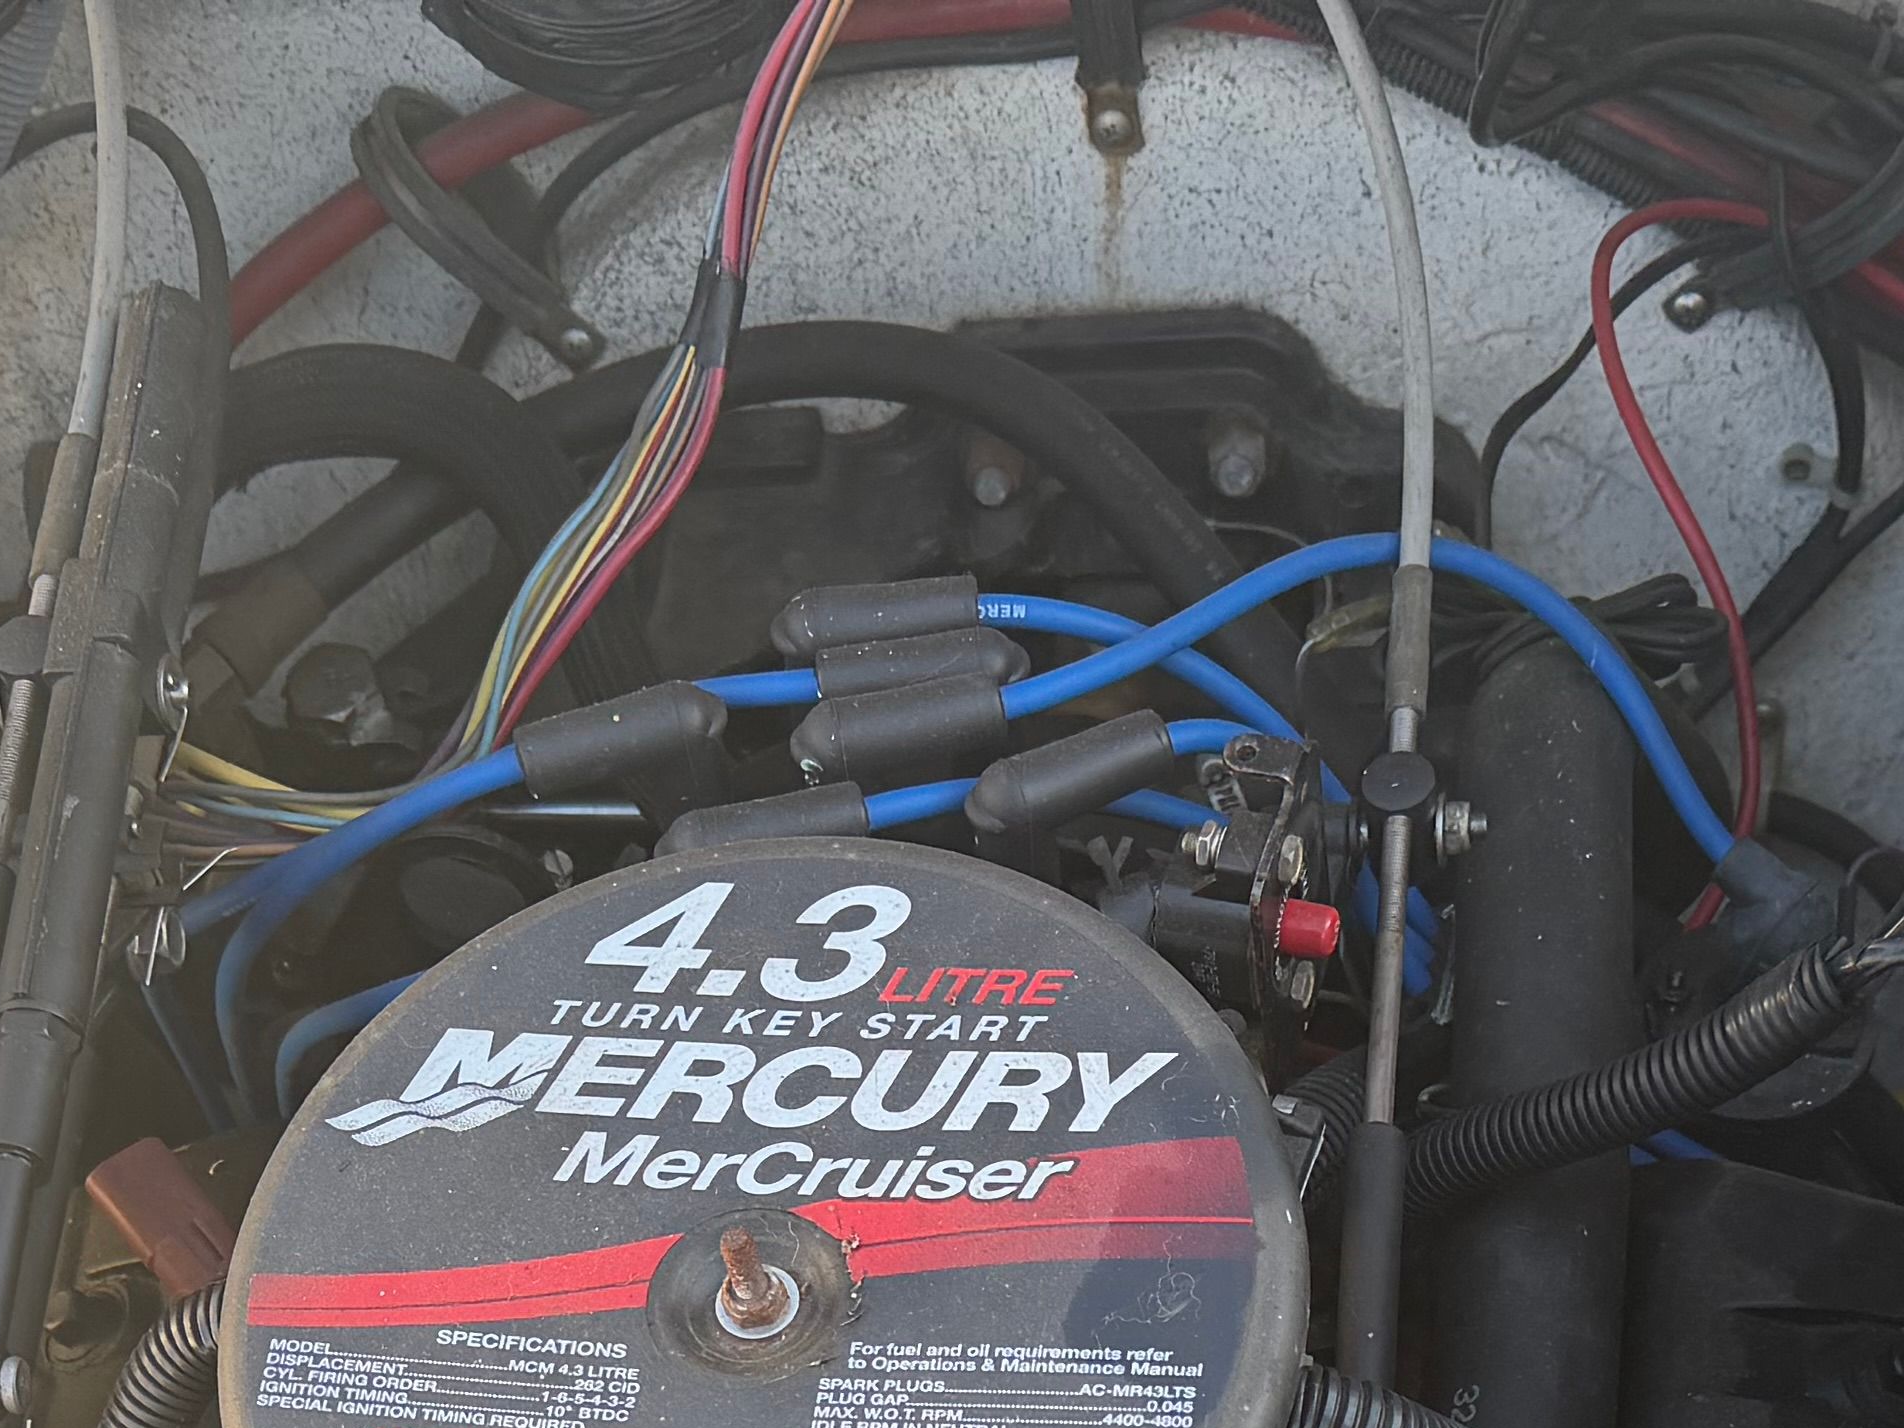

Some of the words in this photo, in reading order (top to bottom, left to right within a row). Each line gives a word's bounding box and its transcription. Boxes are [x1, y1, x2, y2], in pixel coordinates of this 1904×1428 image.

[584, 881, 911, 1001] 4.3
[878, 967, 1077, 1006] LITRE
[550, 999, 704, 1031] TURN
[722, 1007, 842, 1039] KEY
[859, 1013, 1049, 1042] START
[394, 1028, 1179, 1135] MERCURY
[553, 1131, 1073, 1202] MerCruiser
[269, 1338, 332, 1355] MODEL
[508, 1360, 555, 1375] MCM
[558, 1364, 584, 1377] 4.3
[587, 1366, 640, 1381] LITRE
[436, 1329, 628, 1359] SPECIFICATIONS
[850, 1341, 883, 1356] For
[886, 1342, 923, 1357] fuel
[926, 1343, 963, 1358] and
[967, 1344, 991, 1358] oil
[994, 1344, 1122, 1362] requirements
[1126, 1347, 1173, 1362] refer
[263, 1366, 302, 1381] CYL.
[307, 1370, 368, 1387] FIRING
[372, 1376, 438, 1393] ORDER
[266, 1352, 408, 1376] DISPLACEMENT
[608, 1381, 641, 1395] CID
[848, 1356, 867, 1369] to
[872, 1356, 976, 1373] Operations
[980, 1358, 995, 1372] &
[1000, 1358, 1125, 1375] Maintenance
[1131, 1362, 1203, 1377] Manual
[259, 1380, 340, 1399] IGNITION
[344, 1387, 408, 1404] TIMING
[578, 1407, 630, 1422] BTDC
[816, 1392, 865, 1405] PLUG
[870, 1393, 909, 1406] GAP
[1146, 1400, 1194, 1413] 0.045
[818, 1378, 880, 1392] SPARK
[883, 1379, 946, 1393] PLUGS
[1079, 1383, 1197, 1399] AC-MR43LTS
[256, 1394, 332, 1412] SPECIAL
[337, 1401, 417, 1420] IGNITION
[421, 1408, 486, 1426] TIMING
[813, 1406, 858, 1419] MAX.
[864, 1407, 916, 1420] W.O.T.
[921, 1409, 964, 1422] RPM
[1102, 1413, 1193, 1428] 4400-4800
